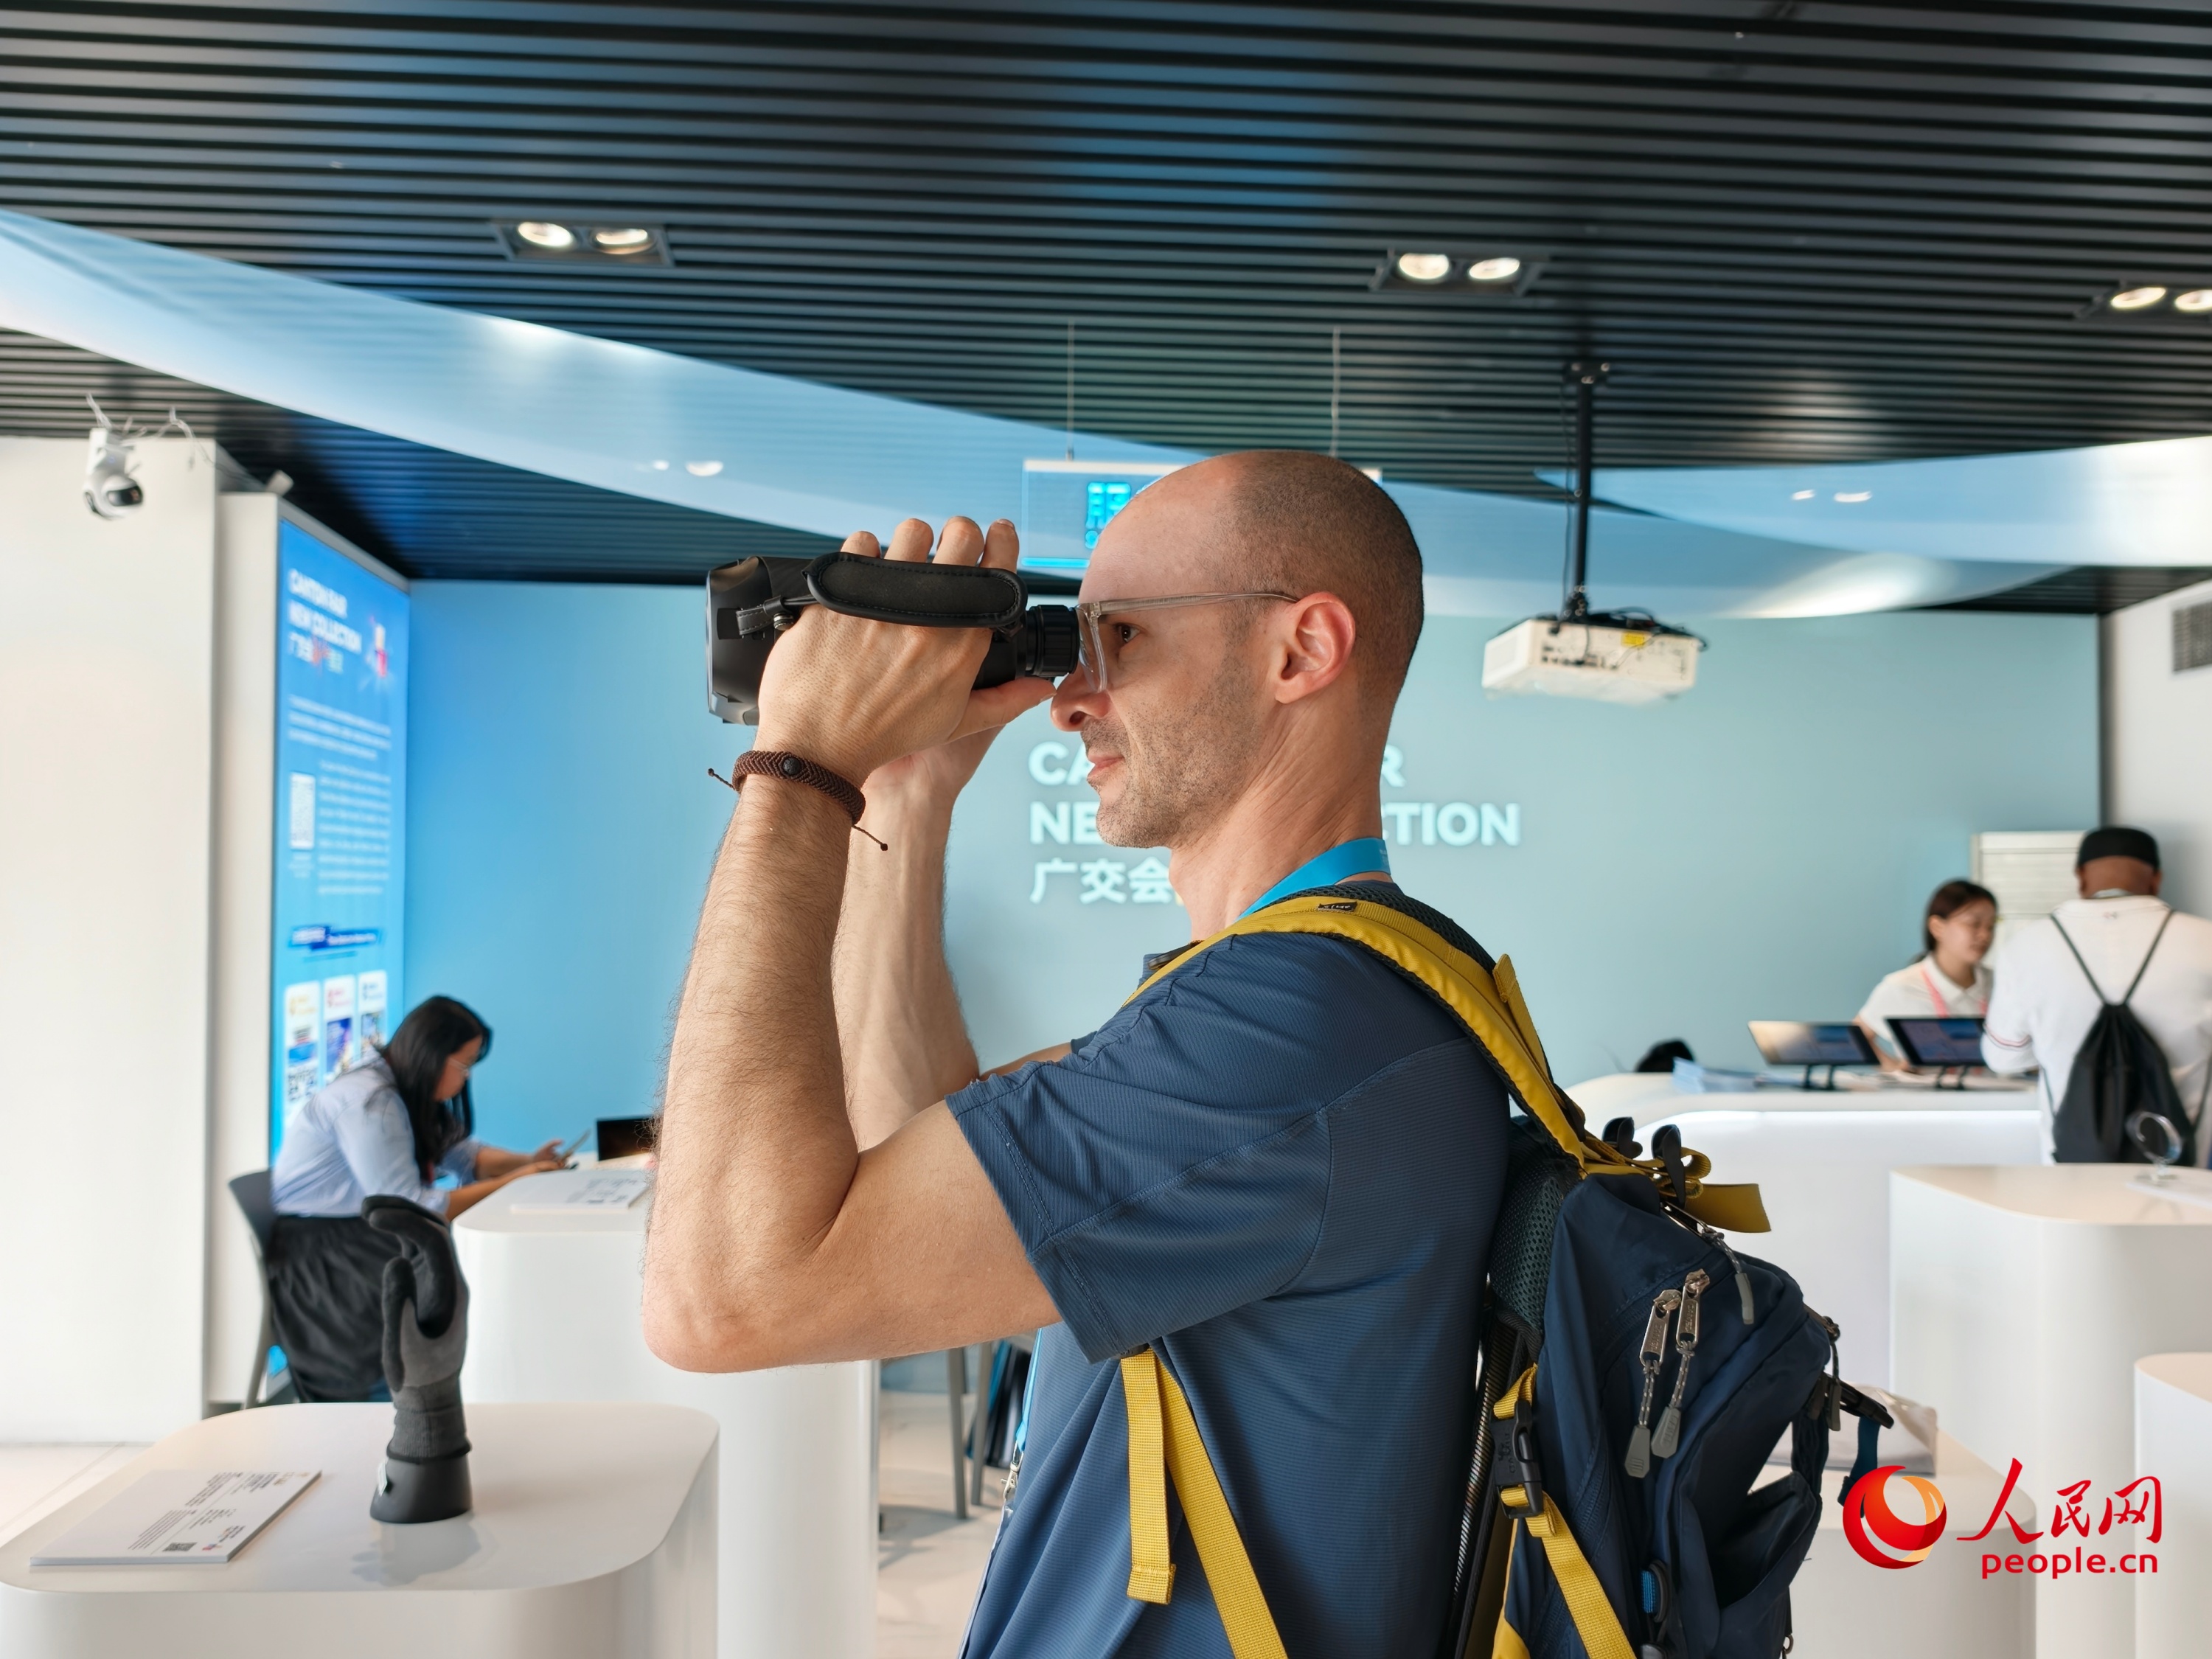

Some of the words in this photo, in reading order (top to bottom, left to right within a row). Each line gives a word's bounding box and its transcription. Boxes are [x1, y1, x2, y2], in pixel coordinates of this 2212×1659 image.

[1030, 801, 1107, 845] NE
[1381, 801, 1521, 846] TION
[1029, 856, 1183, 905] 广交会
